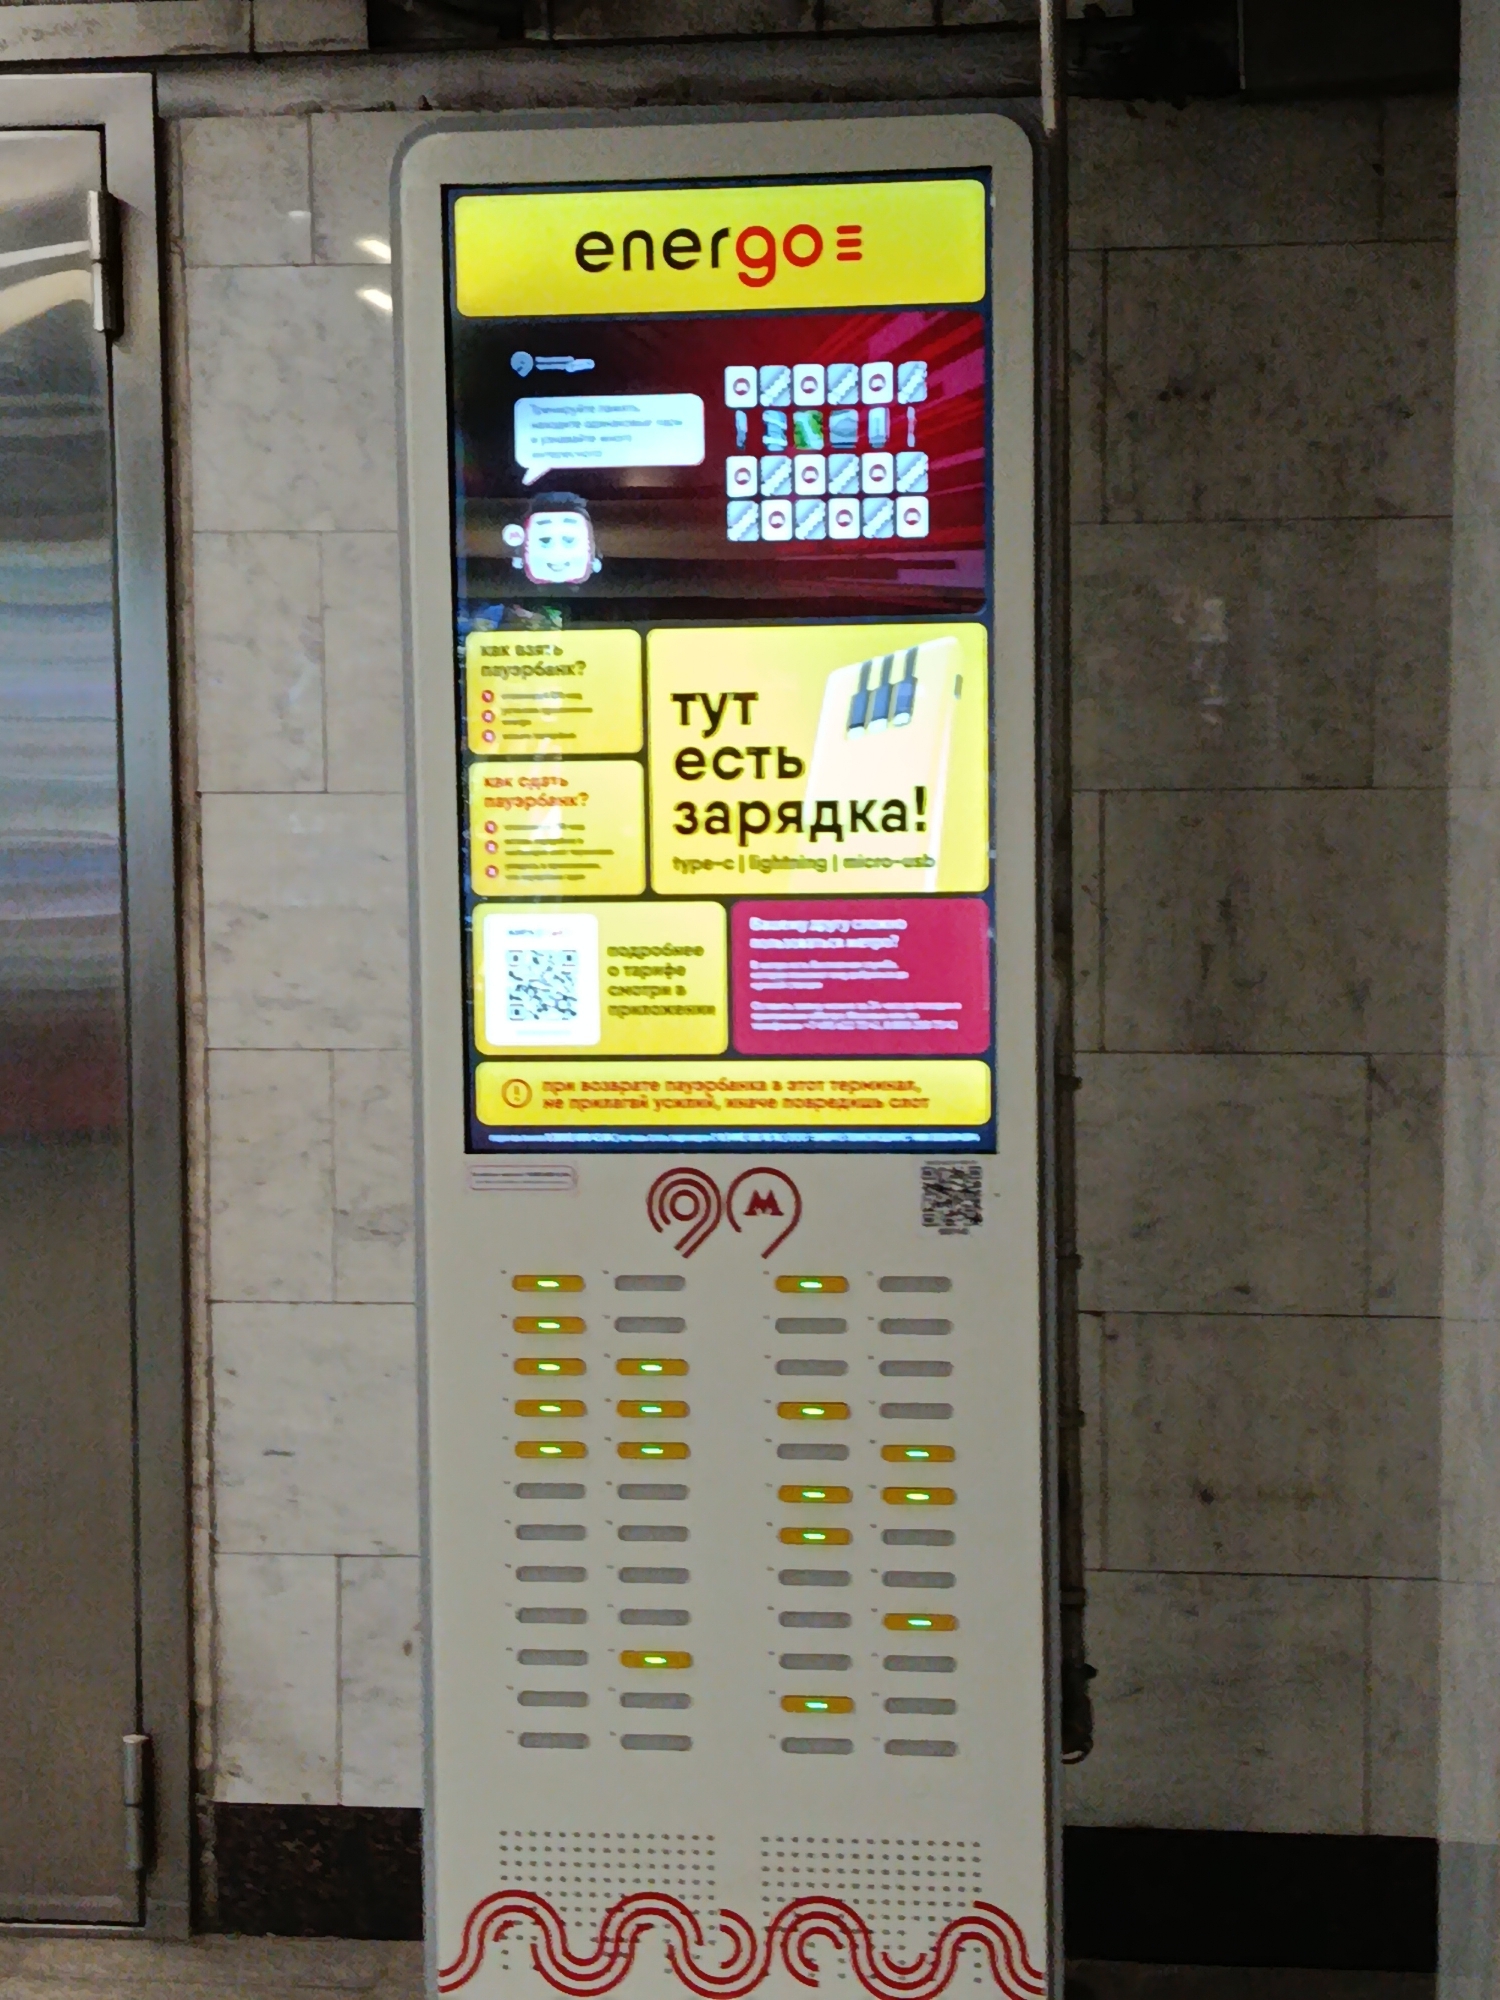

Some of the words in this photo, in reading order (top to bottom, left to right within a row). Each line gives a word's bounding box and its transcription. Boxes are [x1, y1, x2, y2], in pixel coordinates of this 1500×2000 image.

[575, 224, 824, 288] energo
[670, 691, 759, 739] тут
[674, 746, 805, 781] есть
[673, 786, 927, 847] зарядка!
[672, 856, 735, 874] type-c
[749, 854, 827, 874] lightning
